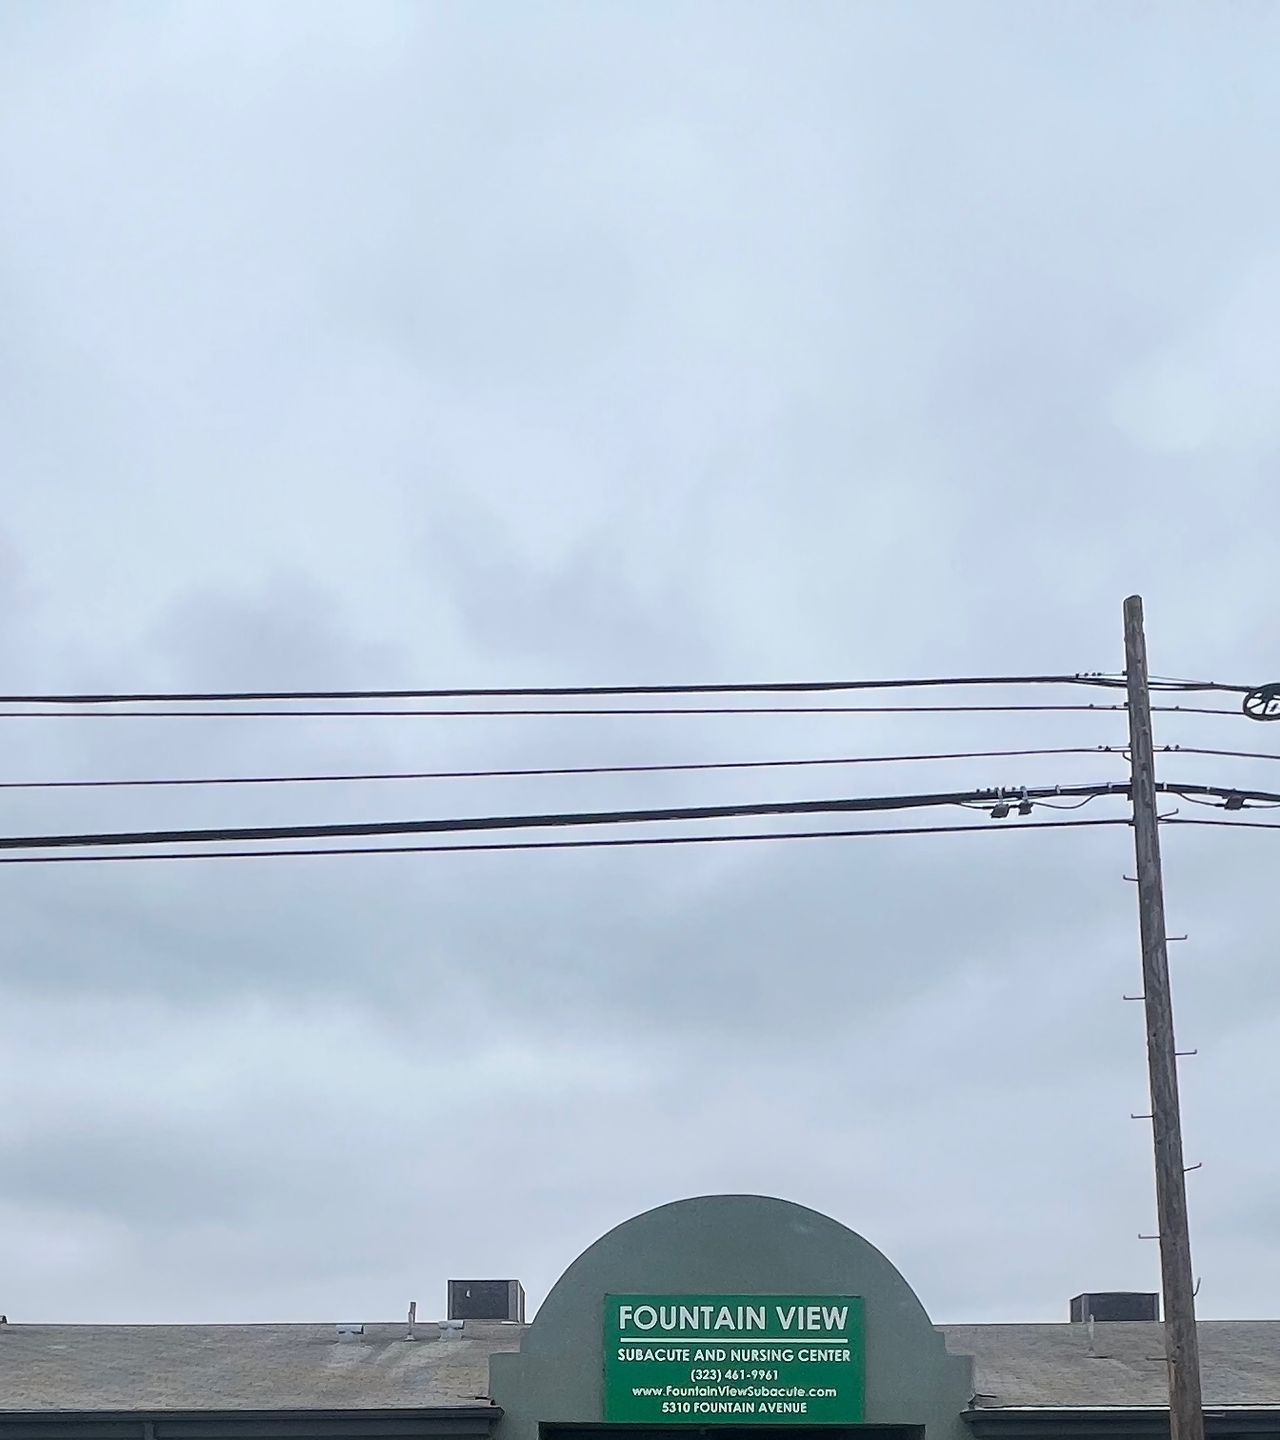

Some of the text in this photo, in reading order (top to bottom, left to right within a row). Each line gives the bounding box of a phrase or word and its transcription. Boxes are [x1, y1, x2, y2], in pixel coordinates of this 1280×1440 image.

[619, 1305, 849, 1330] FOUNTAIN VIEW
[617, 1348, 851, 1362] SUBACUTE AND NURSING CENTER
[690, 1369, 778, 1383] (323) 461-9961
[632, 1385, 837, 1397] www.FountainViewSubacute.com
[661, 1402, 807, 1413] 5310 FOUNTAIN AVENUE
